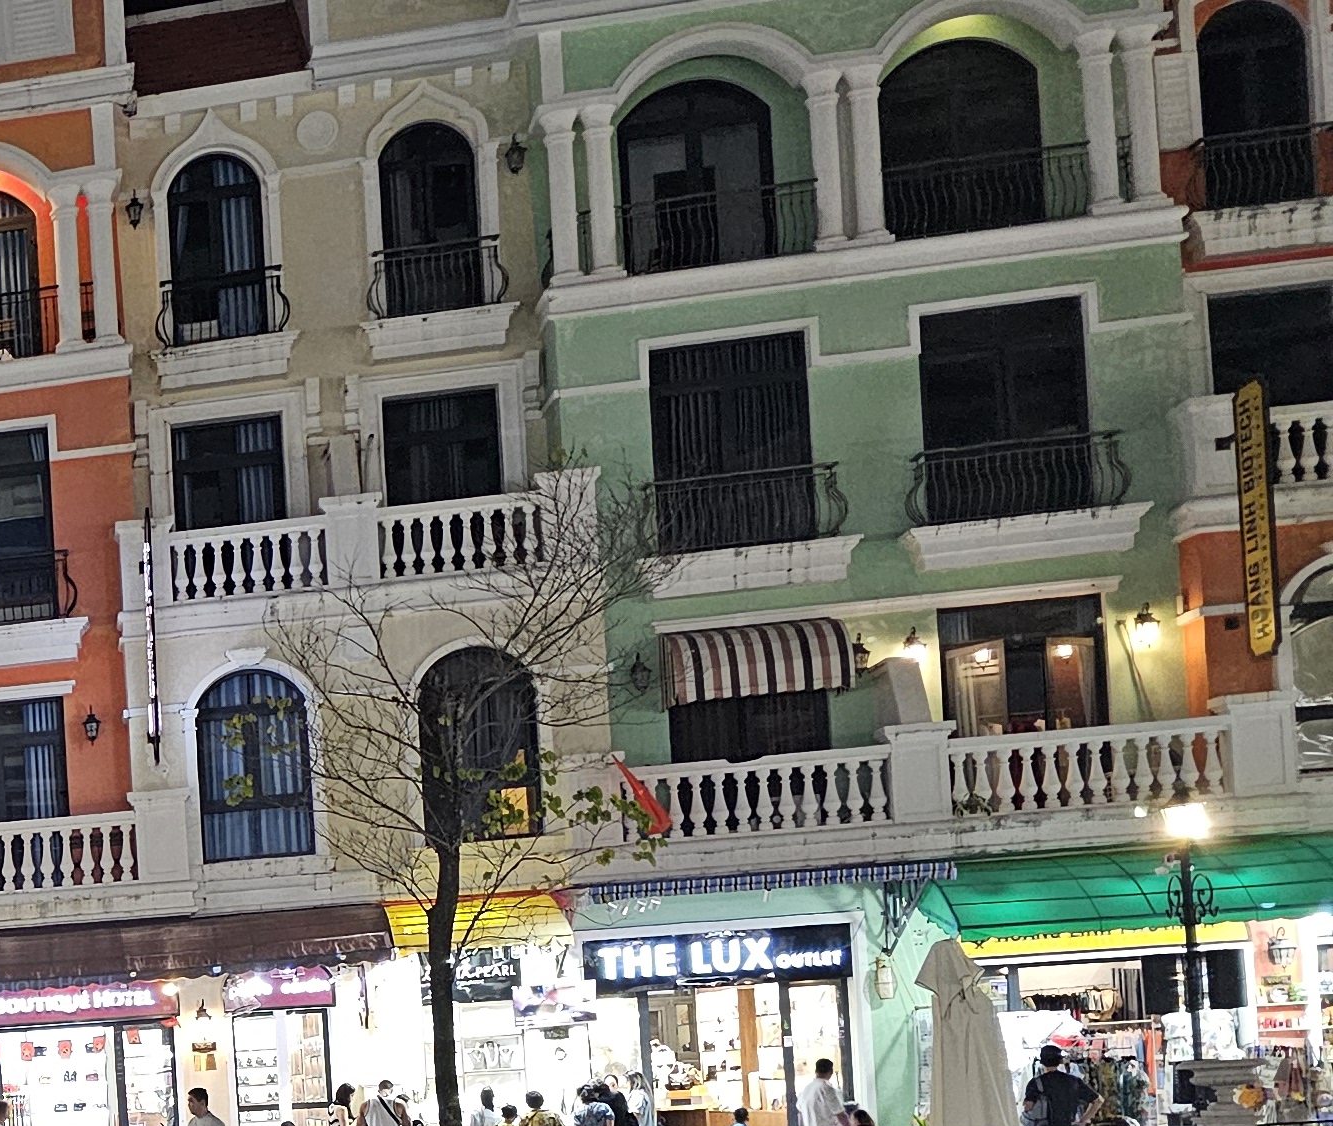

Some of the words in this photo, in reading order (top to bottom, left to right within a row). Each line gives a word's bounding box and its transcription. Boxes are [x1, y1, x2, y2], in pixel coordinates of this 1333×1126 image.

[1239, 398, 1256, 495] BIOTECH
[1242, 501, 1259, 554] LINH
[597, 943, 677, 981] THE
[690, 937, 774, 975] LUX
[775, 950, 842, 969] OUTLET
[92, 989, 156, 1008] HOTEL
